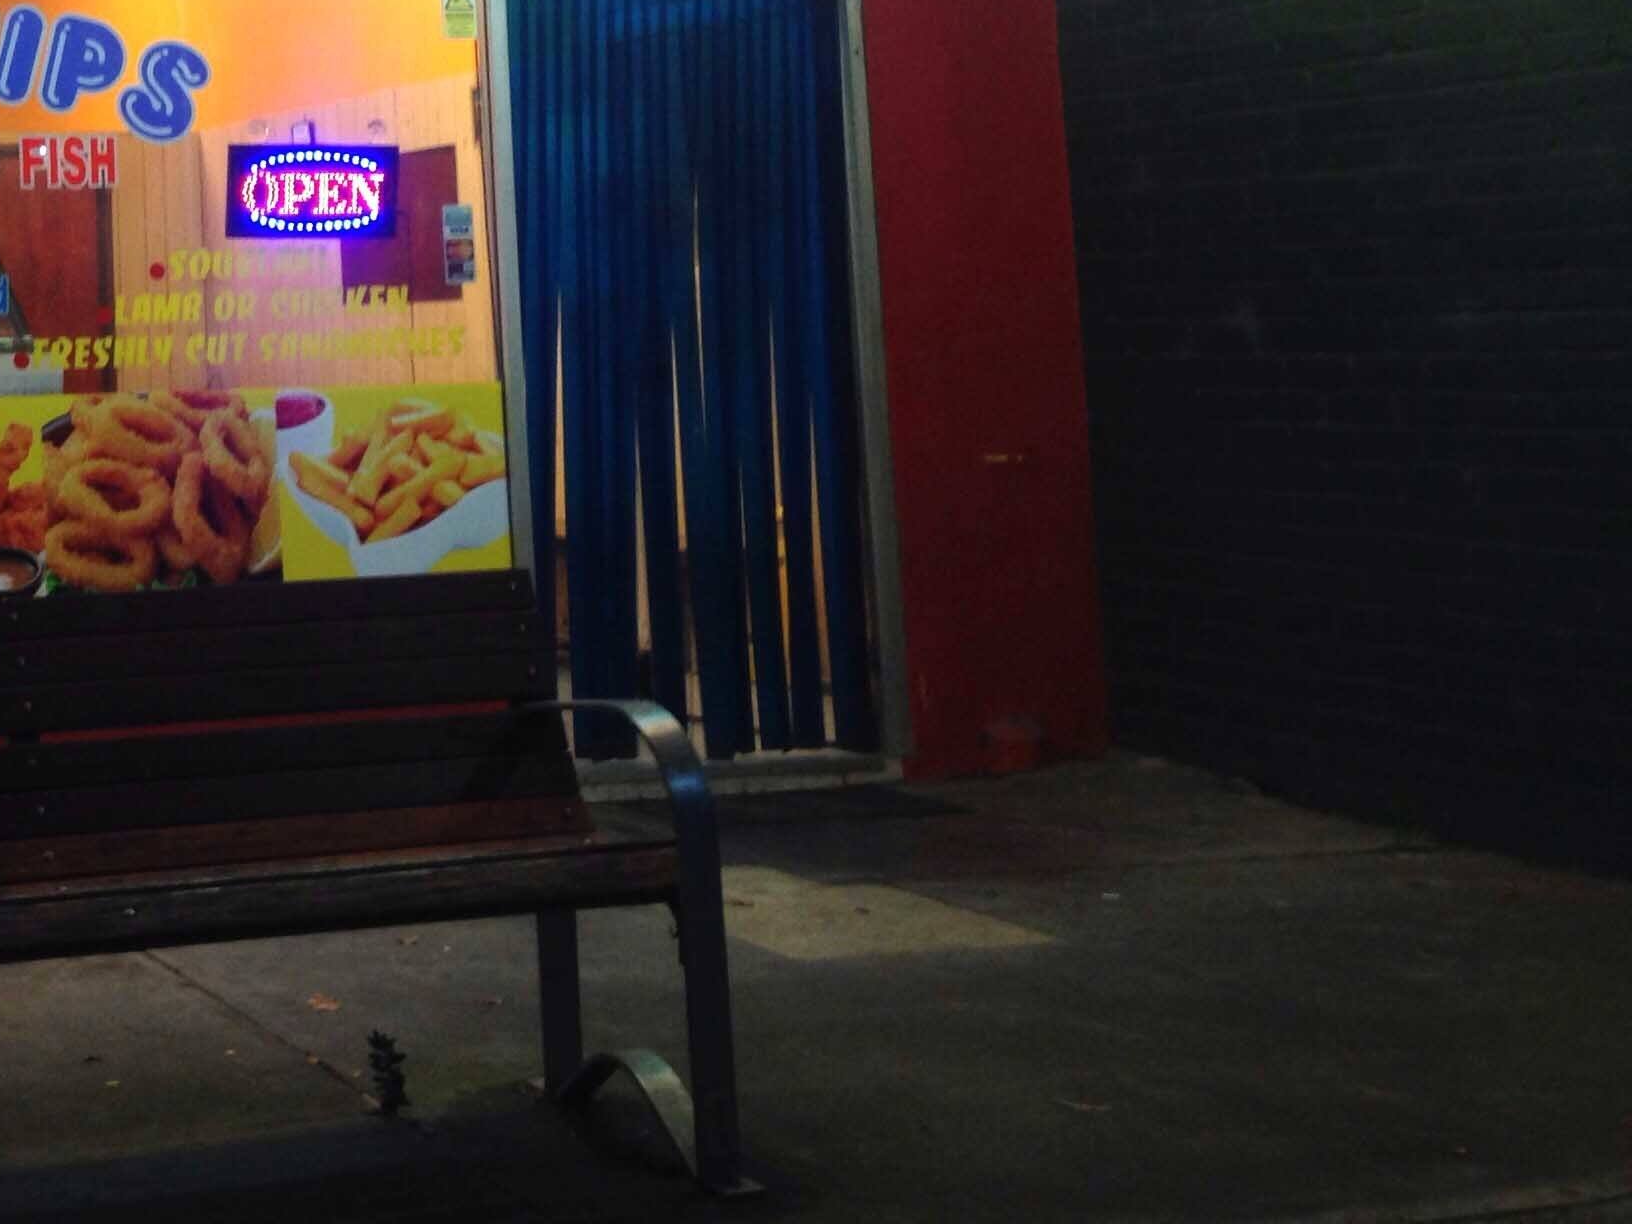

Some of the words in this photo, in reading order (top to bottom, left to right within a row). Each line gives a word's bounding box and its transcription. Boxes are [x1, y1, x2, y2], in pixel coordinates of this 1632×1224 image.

[19, 135, 119, 190] FISH
[241, 172, 384, 216] OPEN
[115, 287, 203, 326] LAMB
[214, 289, 256, 322] OR
[31, 332, 170, 371] FRESHLY
[186, 330, 245, 366] CUT
